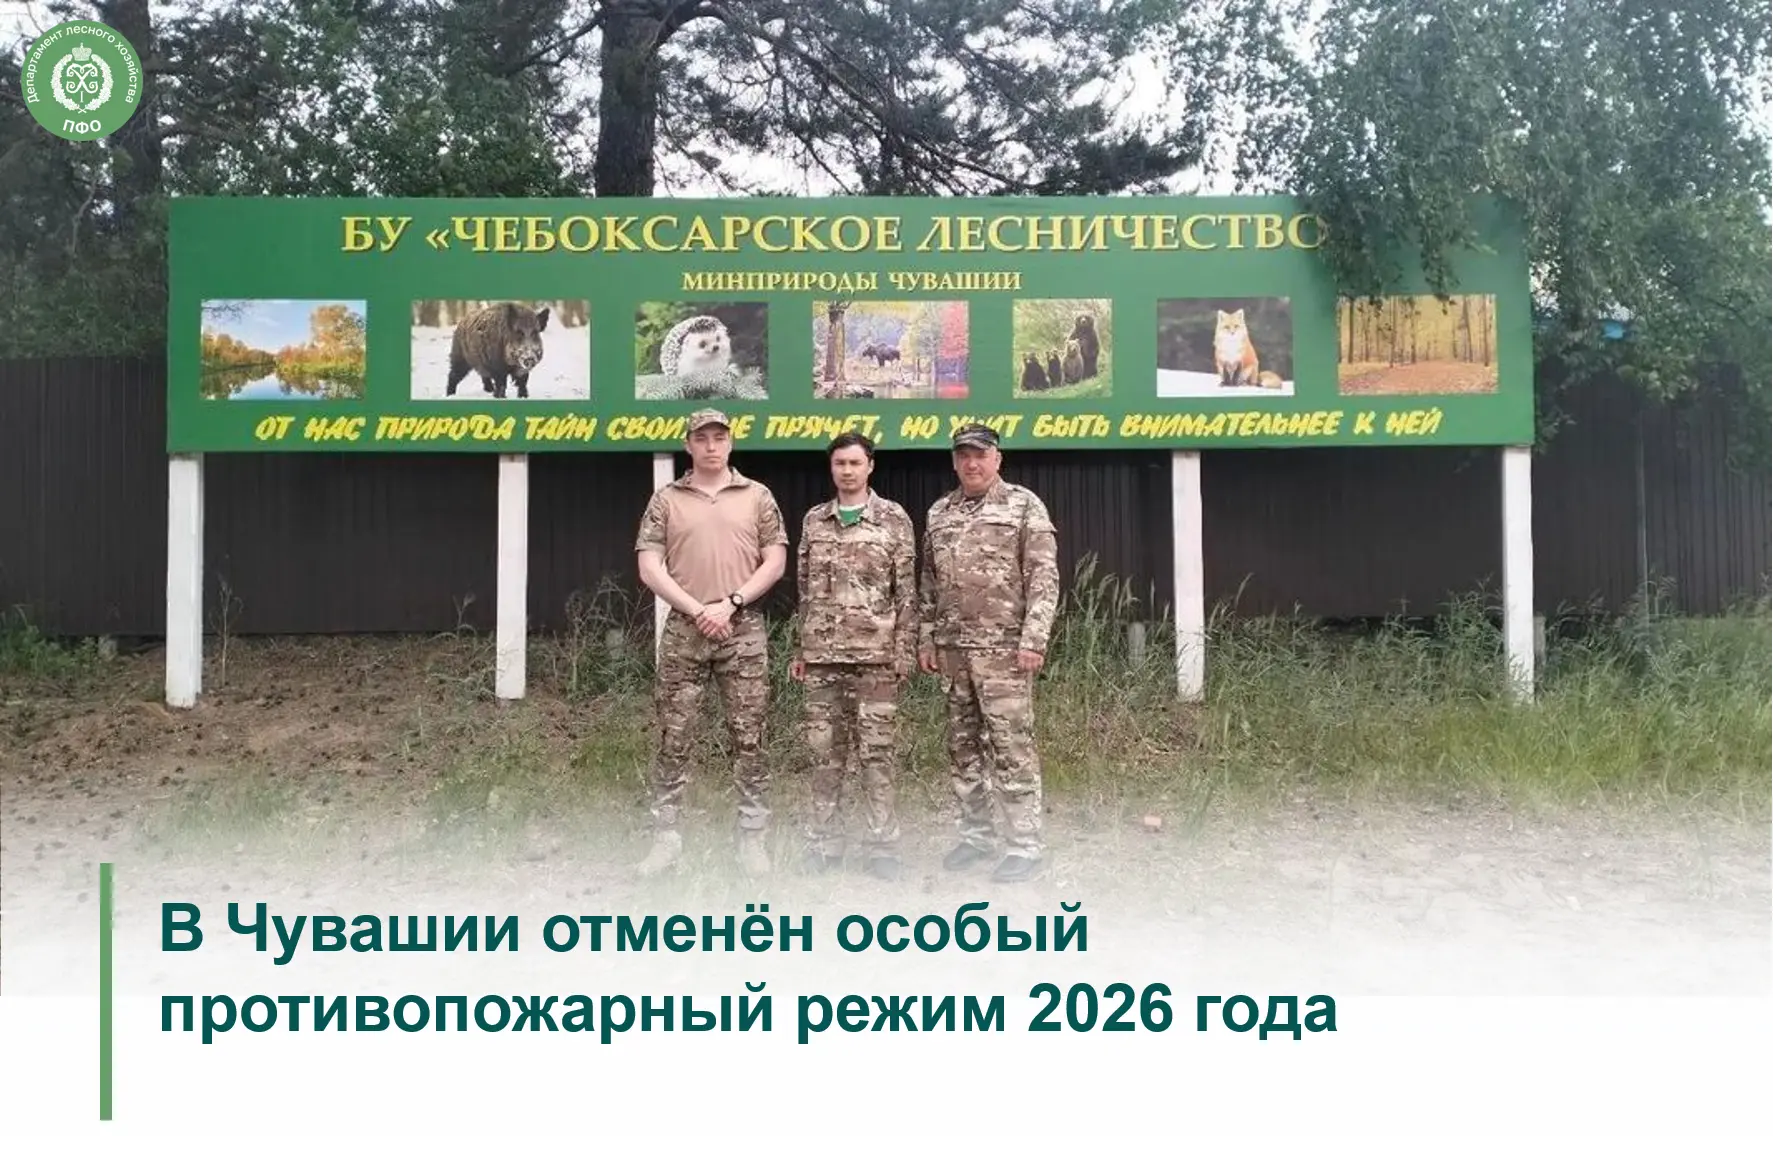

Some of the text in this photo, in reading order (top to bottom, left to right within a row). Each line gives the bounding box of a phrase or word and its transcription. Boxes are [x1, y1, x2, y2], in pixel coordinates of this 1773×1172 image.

[341, 212, 1329, 253] БУ «ЧЕБОКСАРСКОЕ ЛЕСНИЧЕСТВО
[682, 271, 1022, 293] МИНПРИРОДЫ ЧУВАШИИ
[255, 416, 295, 440] ОТ
[304, 416, 364, 442] НАС
[375, 414, 516, 442] ПРИРОДА
[525, 413, 598, 441] ТАЙН
[765, 414, 885, 443] ПРЯЧЕТ,
[900, 415, 940, 440] НО
[1032, 414, 1112, 438] БЫТЬ
[1119, 411, 1344, 438] ВНИМАТЕЛЬНЕЕ
[1353, 413, 1376, 434] К
[1385, 408, 1443, 435] НЕЙ
